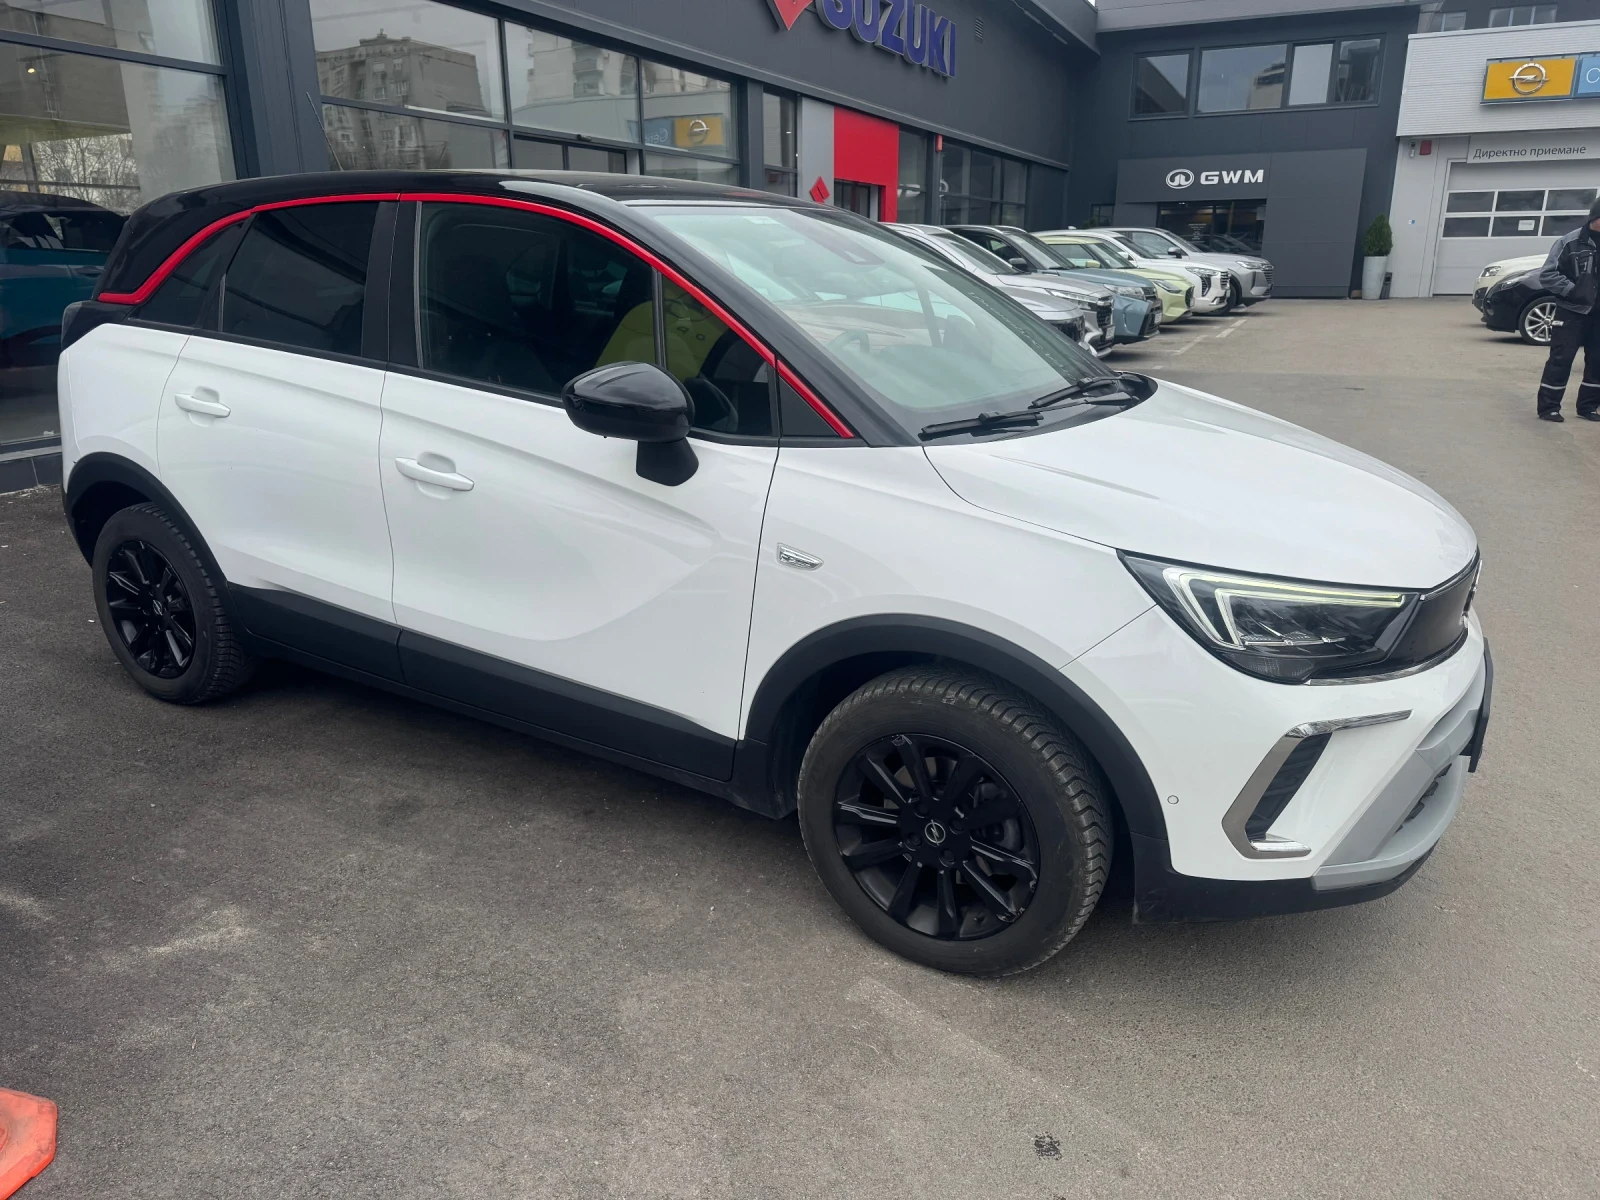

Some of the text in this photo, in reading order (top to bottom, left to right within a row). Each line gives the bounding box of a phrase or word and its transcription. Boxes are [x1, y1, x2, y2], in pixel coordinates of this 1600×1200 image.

[1473, 146, 1587, 160] Директно приемане
[1200, 169, 1265, 185] GWM
